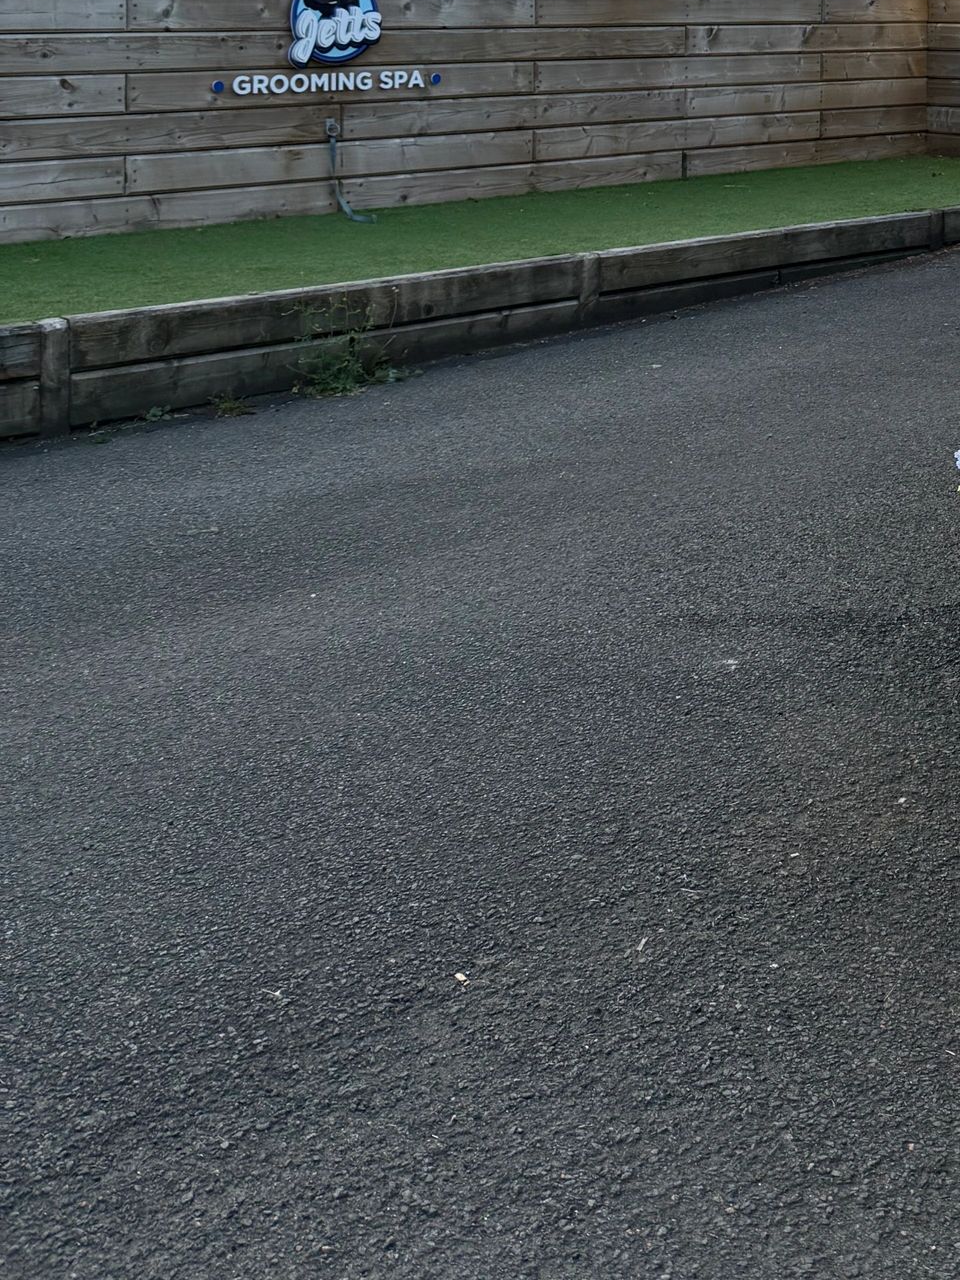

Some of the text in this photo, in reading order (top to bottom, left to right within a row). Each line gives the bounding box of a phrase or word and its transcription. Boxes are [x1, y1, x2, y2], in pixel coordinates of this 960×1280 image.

[289, 6, 382, 64] Jetts
[232, 70, 425, 95] GROOMING SPA
